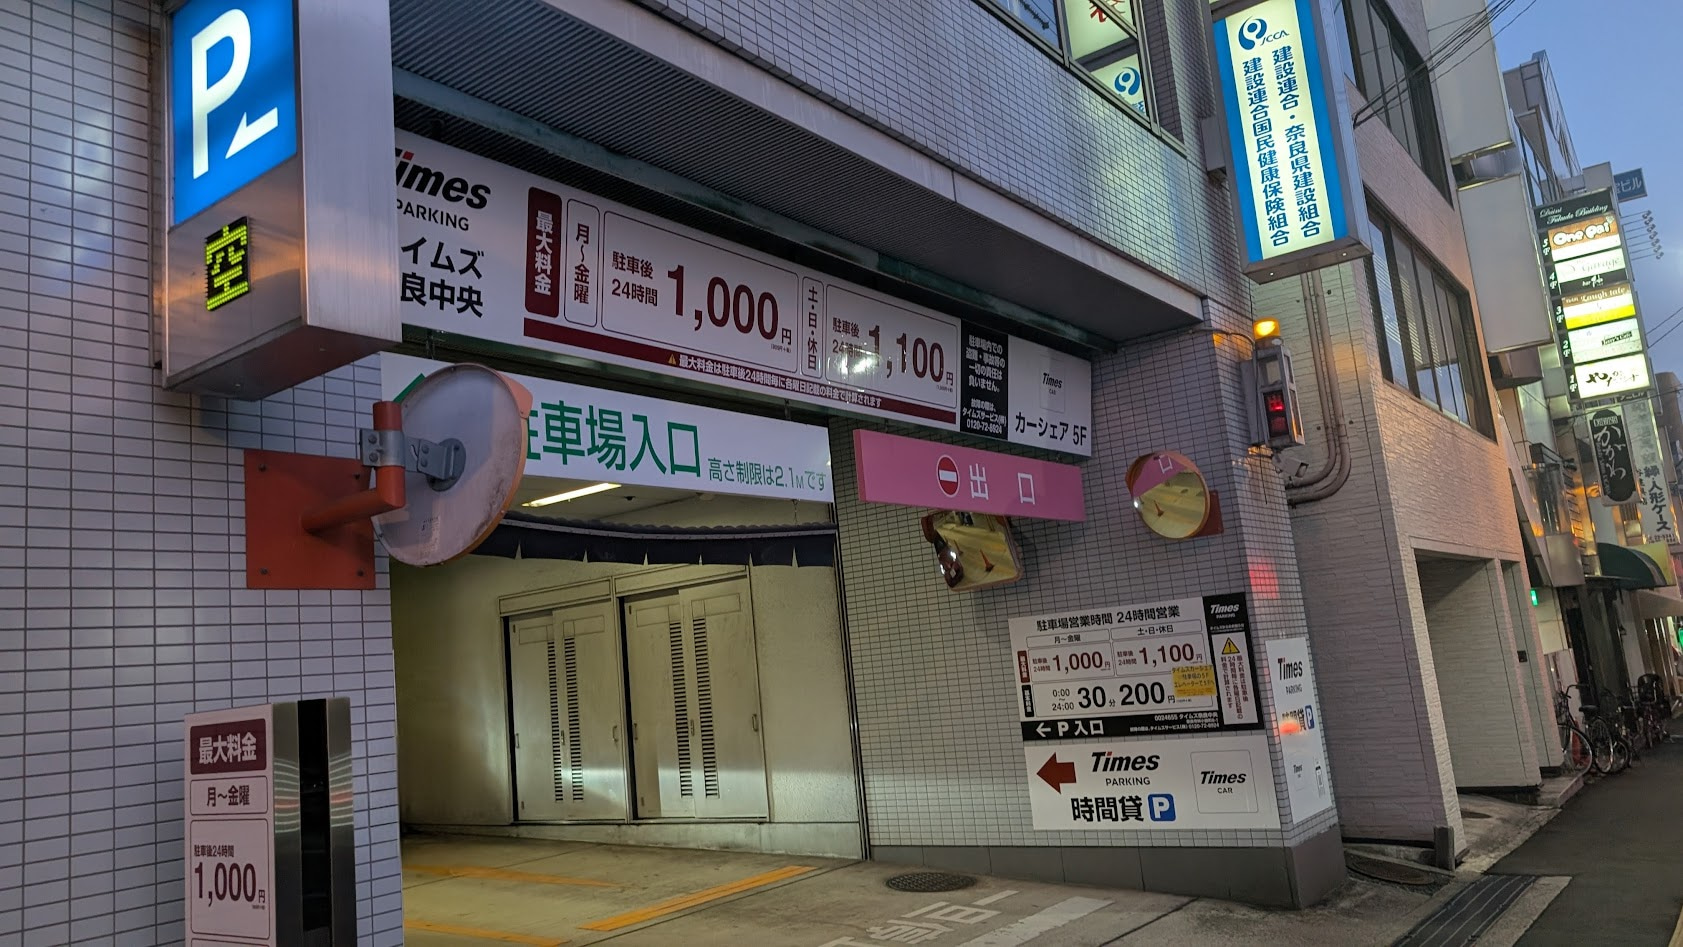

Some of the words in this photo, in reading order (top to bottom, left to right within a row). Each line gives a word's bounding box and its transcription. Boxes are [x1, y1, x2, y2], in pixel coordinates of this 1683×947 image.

[192, 9, 251, 180] P
[1242, 57, 1290, 247] 建設連合国民健康保険組合
[1272, 45, 1321, 239] 建設連合・奈良県建設組合
[395, 148, 491, 209] imes
[1553, 231, 1584, 246] One
[534, 210, 554, 297] 最大料金
[611, 250, 654, 280] 駐車後
[206, 225, 250, 311] 空
[400, 271, 483, 318] 良中央
[611, 278, 658, 307] 24時間
[832, 317, 860, 338] 駐車後
[1042, 372, 1063, 389] Times
[1015, 411, 1069, 440] カーシェア
[1072, 424, 1088, 446] 5F
[1036, 612, 1113, 632] 駐車場営業時間
[1117, 605, 1180, 624] 24時間営業
[1210, 603, 1240, 614] Times
[1277, 657, 1303, 680] Times
[1052, 689, 1070, 698] 0:00
[1052, 702, 1074, 711] 24:00
[1075, 720, 1105, 735] 入口
[198, 732, 257, 765] 最大料金
[1091, 750, 1160, 773] Times
[1105, 777, 1151, 787] PARKING
[1200, 771, 1247, 785] Times
[1071, 796, 1144, 823] 時間貸
[194, 844, 235, 858] 駐車後24時間
